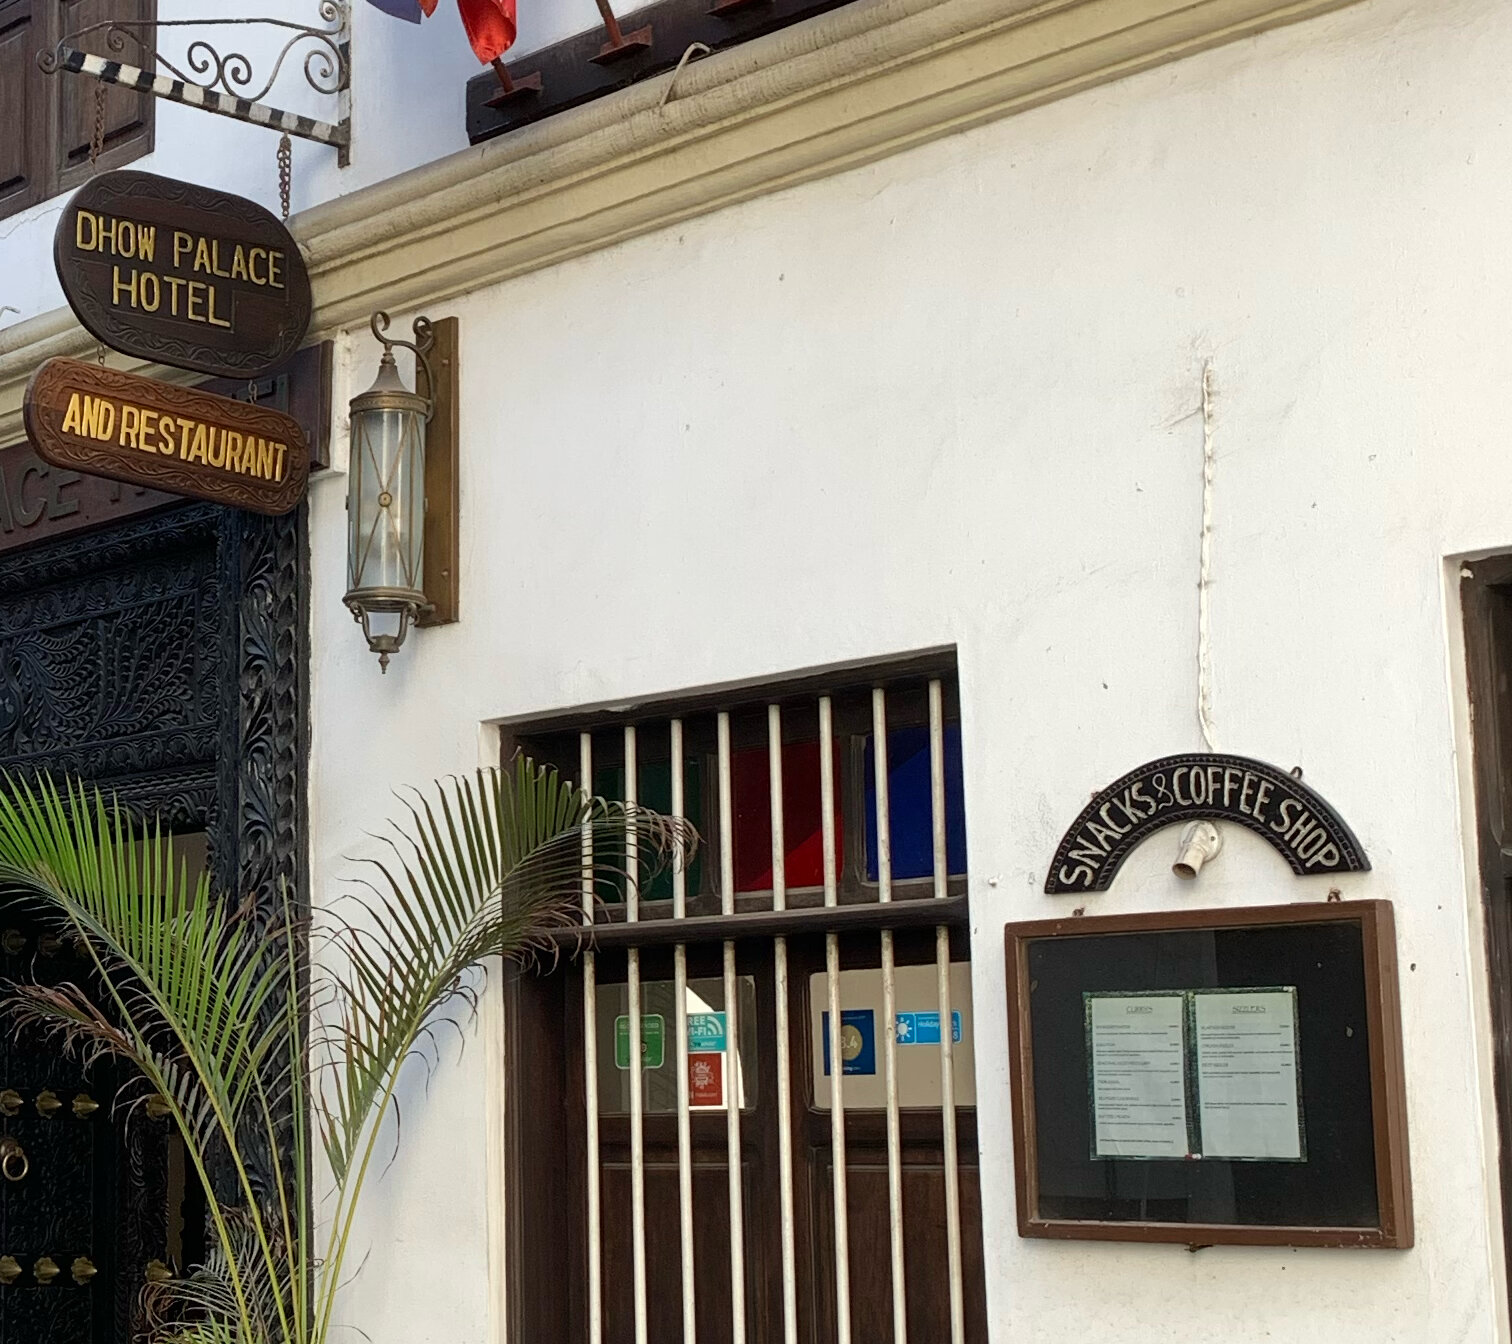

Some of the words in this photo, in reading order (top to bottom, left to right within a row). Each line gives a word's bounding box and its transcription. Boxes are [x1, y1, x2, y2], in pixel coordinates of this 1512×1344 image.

[76, 210, 156, 262] DHOW
[173, 232, 285, 289] PALACE
[112, 265, 231, 328] HOTEL
[62, 393, 115, 441] AND
[119, 405, 287, 482] RESTAURANT
[1059, 782, 1157, 886] SNACKS
[1152, 773, 1174, 809] &
[1172, 766, 1275, 823] COFFEE
[1270, 798, 1340, 868] SHOP
[688, 1016, 706, 1025] REE
